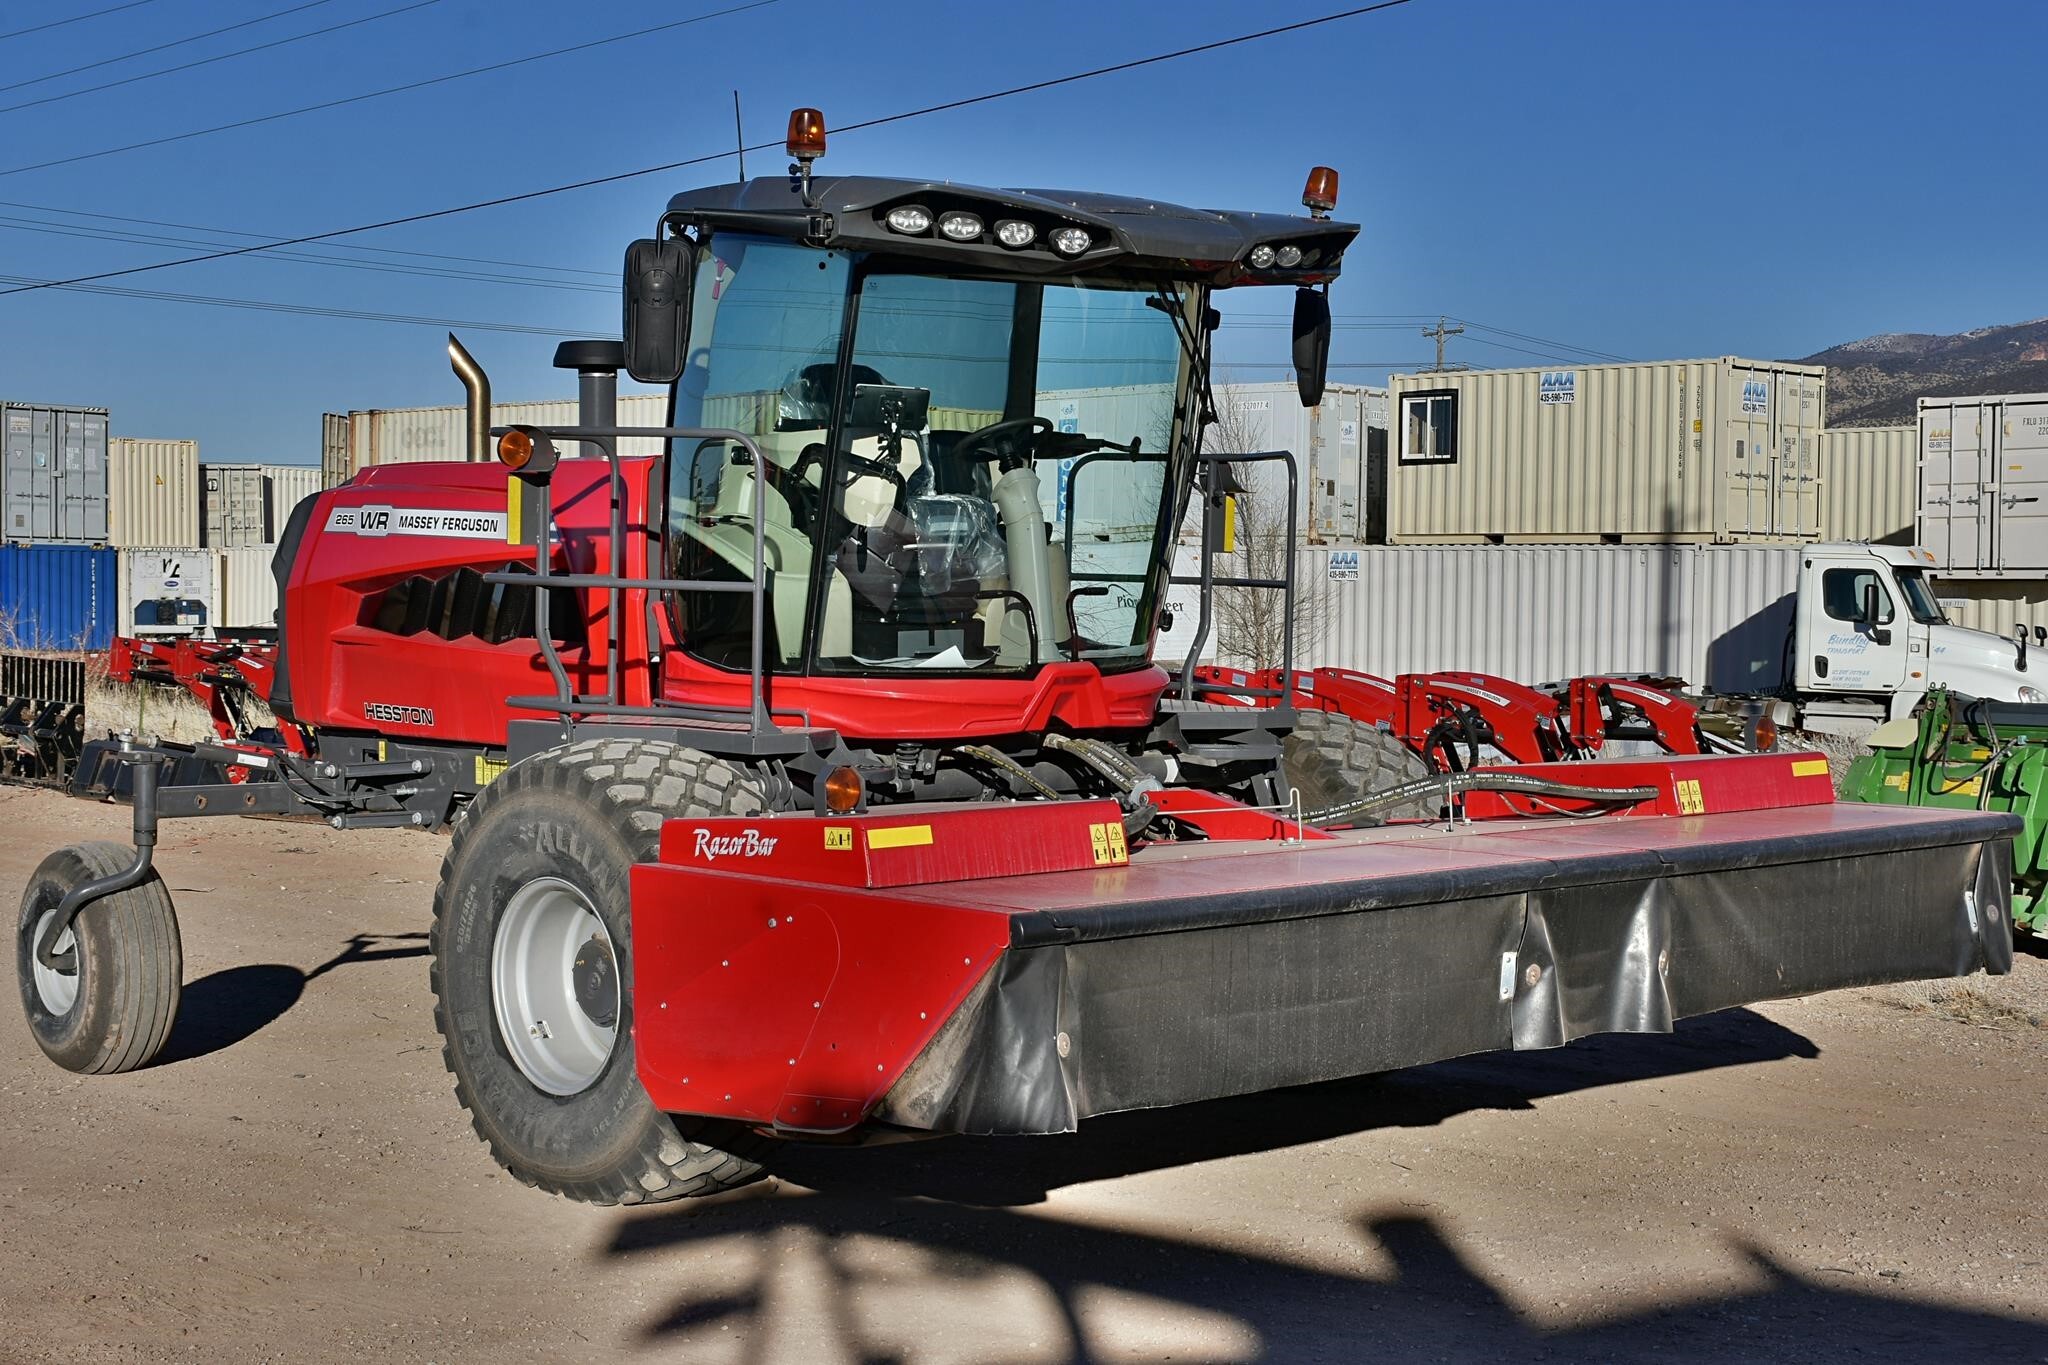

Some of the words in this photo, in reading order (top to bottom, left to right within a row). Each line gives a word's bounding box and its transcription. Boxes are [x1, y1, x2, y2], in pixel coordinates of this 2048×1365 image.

[1541, 371, 1575, 387] AAA
[1540, 392, 1575, 402] 435-590-7775
[335, 514, 354, 525] 265
[360, 511, 390, 530] WR
[398, 515, 440, 530] MASSEY
[441, 517, 499, 533] FERGUSON
[363, 702, 435, 727] HESSTON
